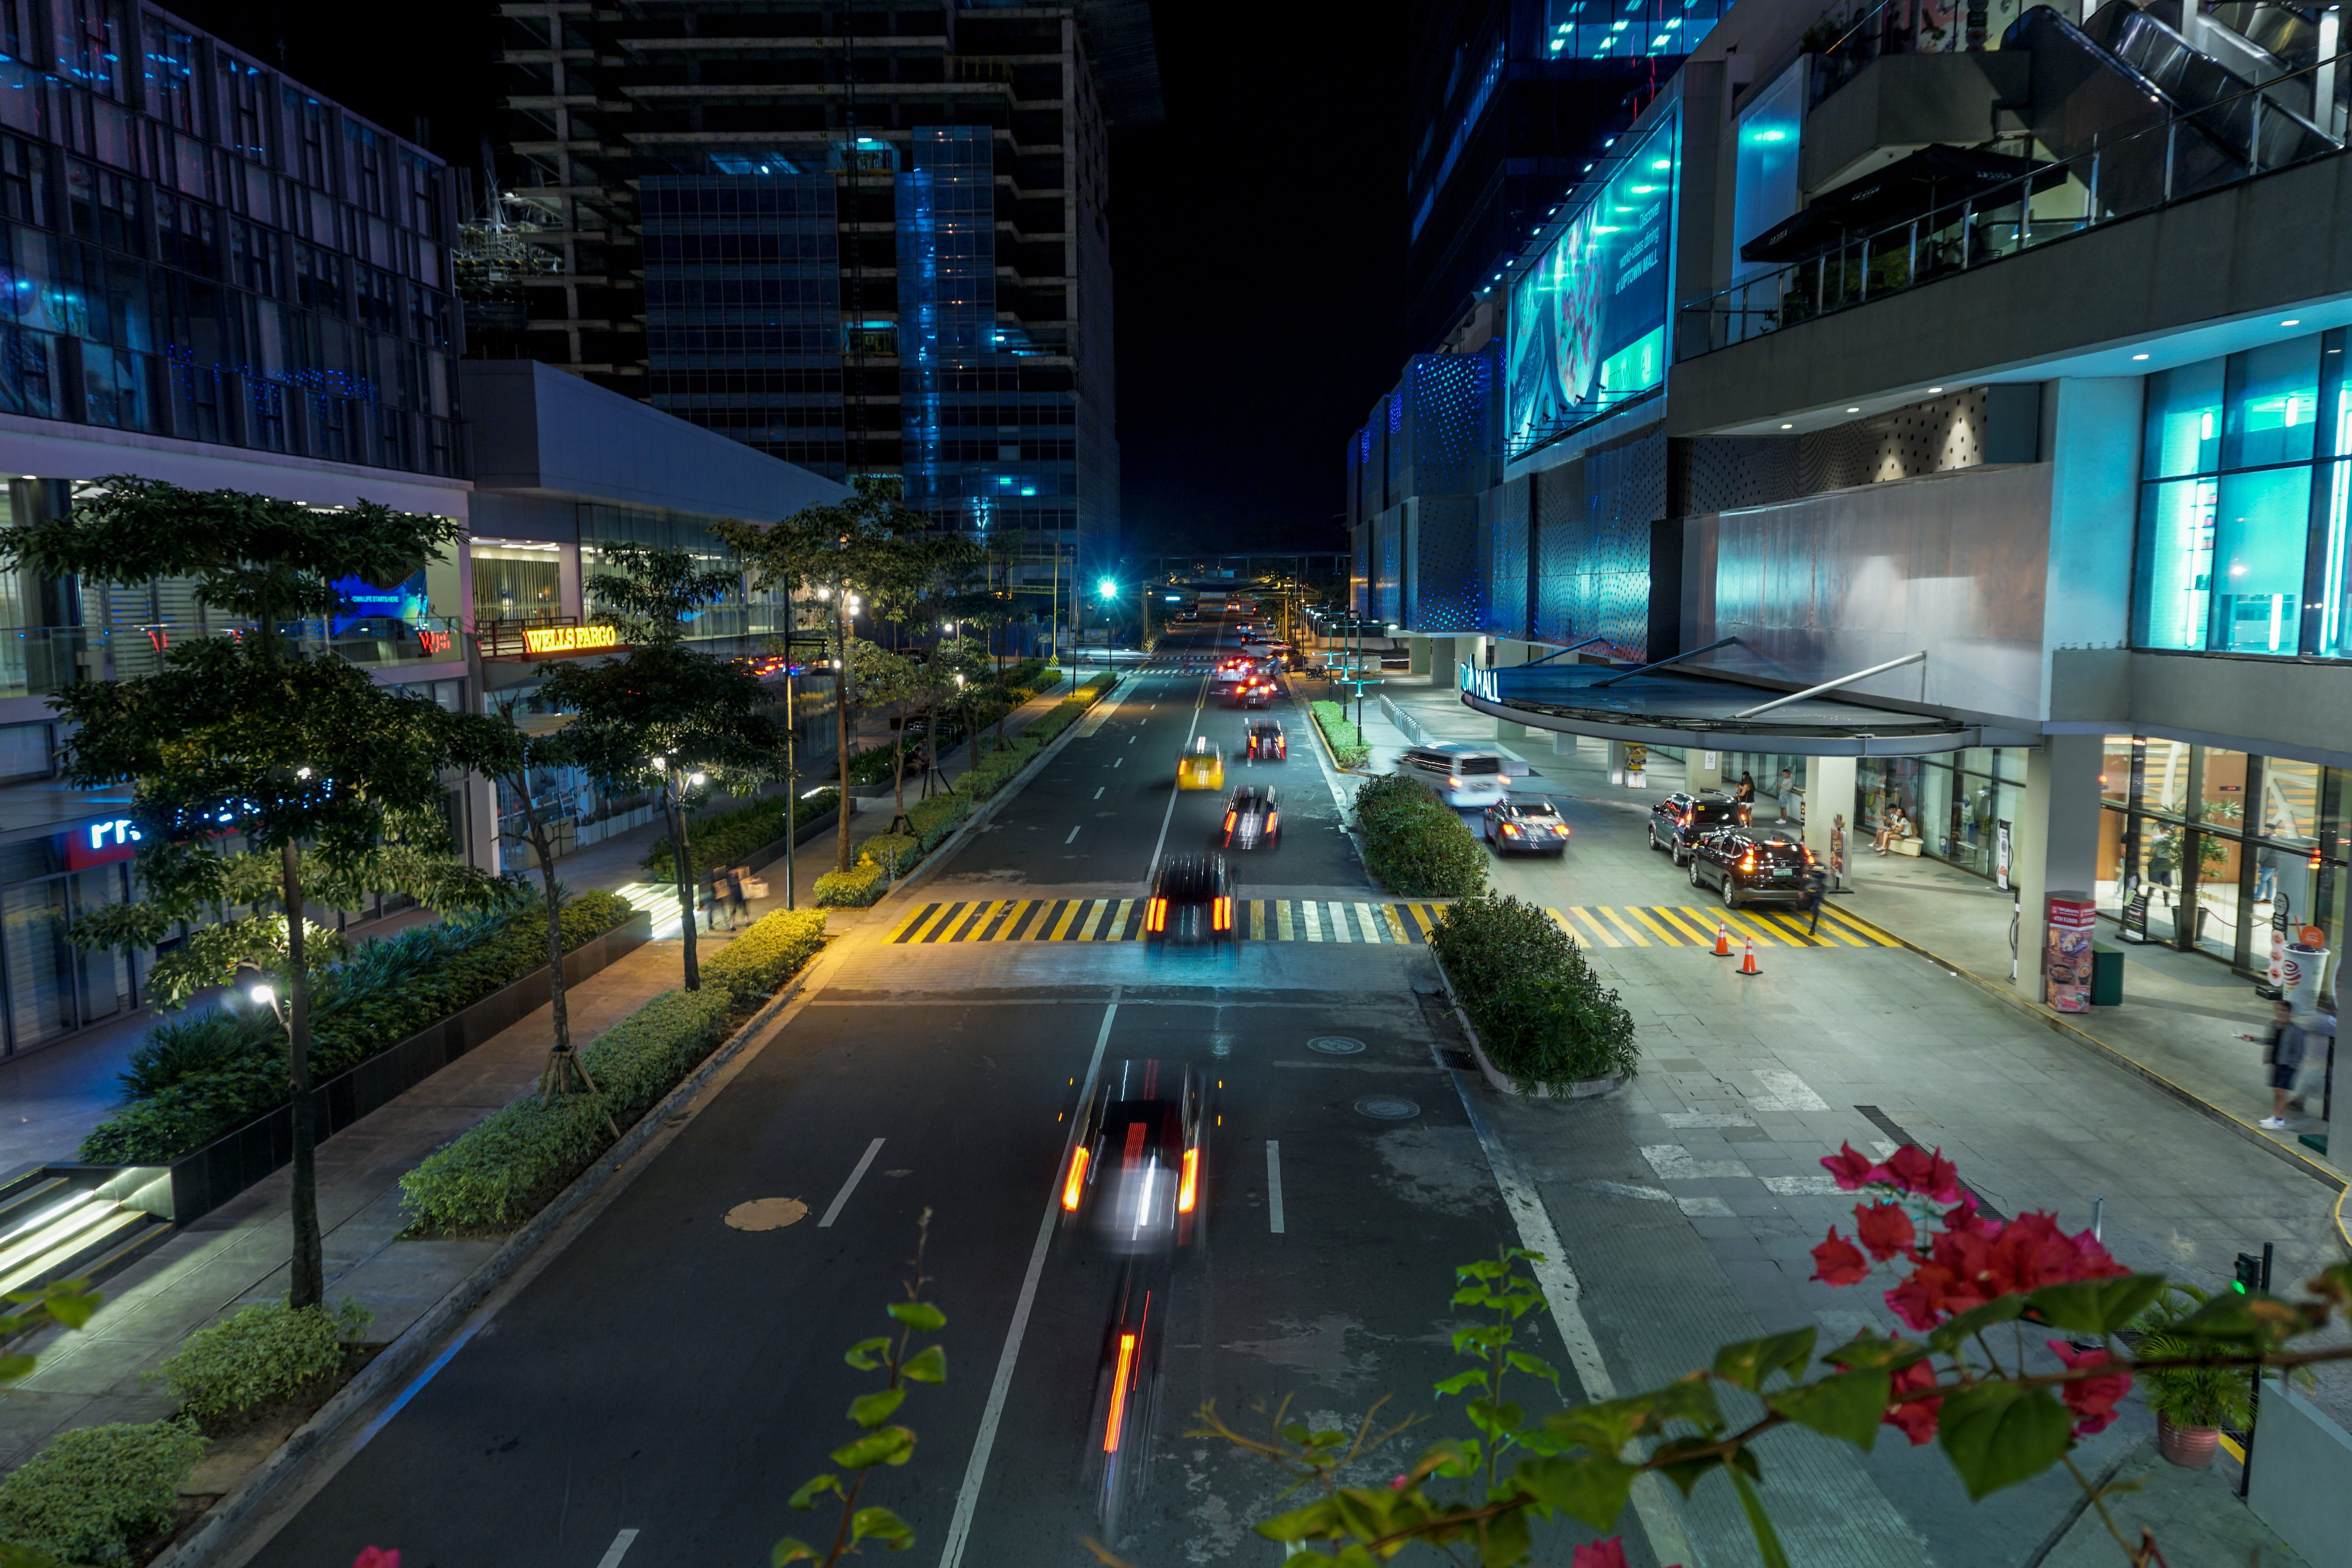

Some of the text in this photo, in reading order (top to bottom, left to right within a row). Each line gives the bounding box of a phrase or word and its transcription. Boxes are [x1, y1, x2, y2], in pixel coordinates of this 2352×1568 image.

[1639, 200, 1661, 230] Discover
[1619, 226, 1659, 269] world-class dining
[1615, 248, 1659, 295] at UPTOWN MALL
[524, 625, 616, 653] WELLS FARGO
[1475, 669, 1501, 702] MALL
